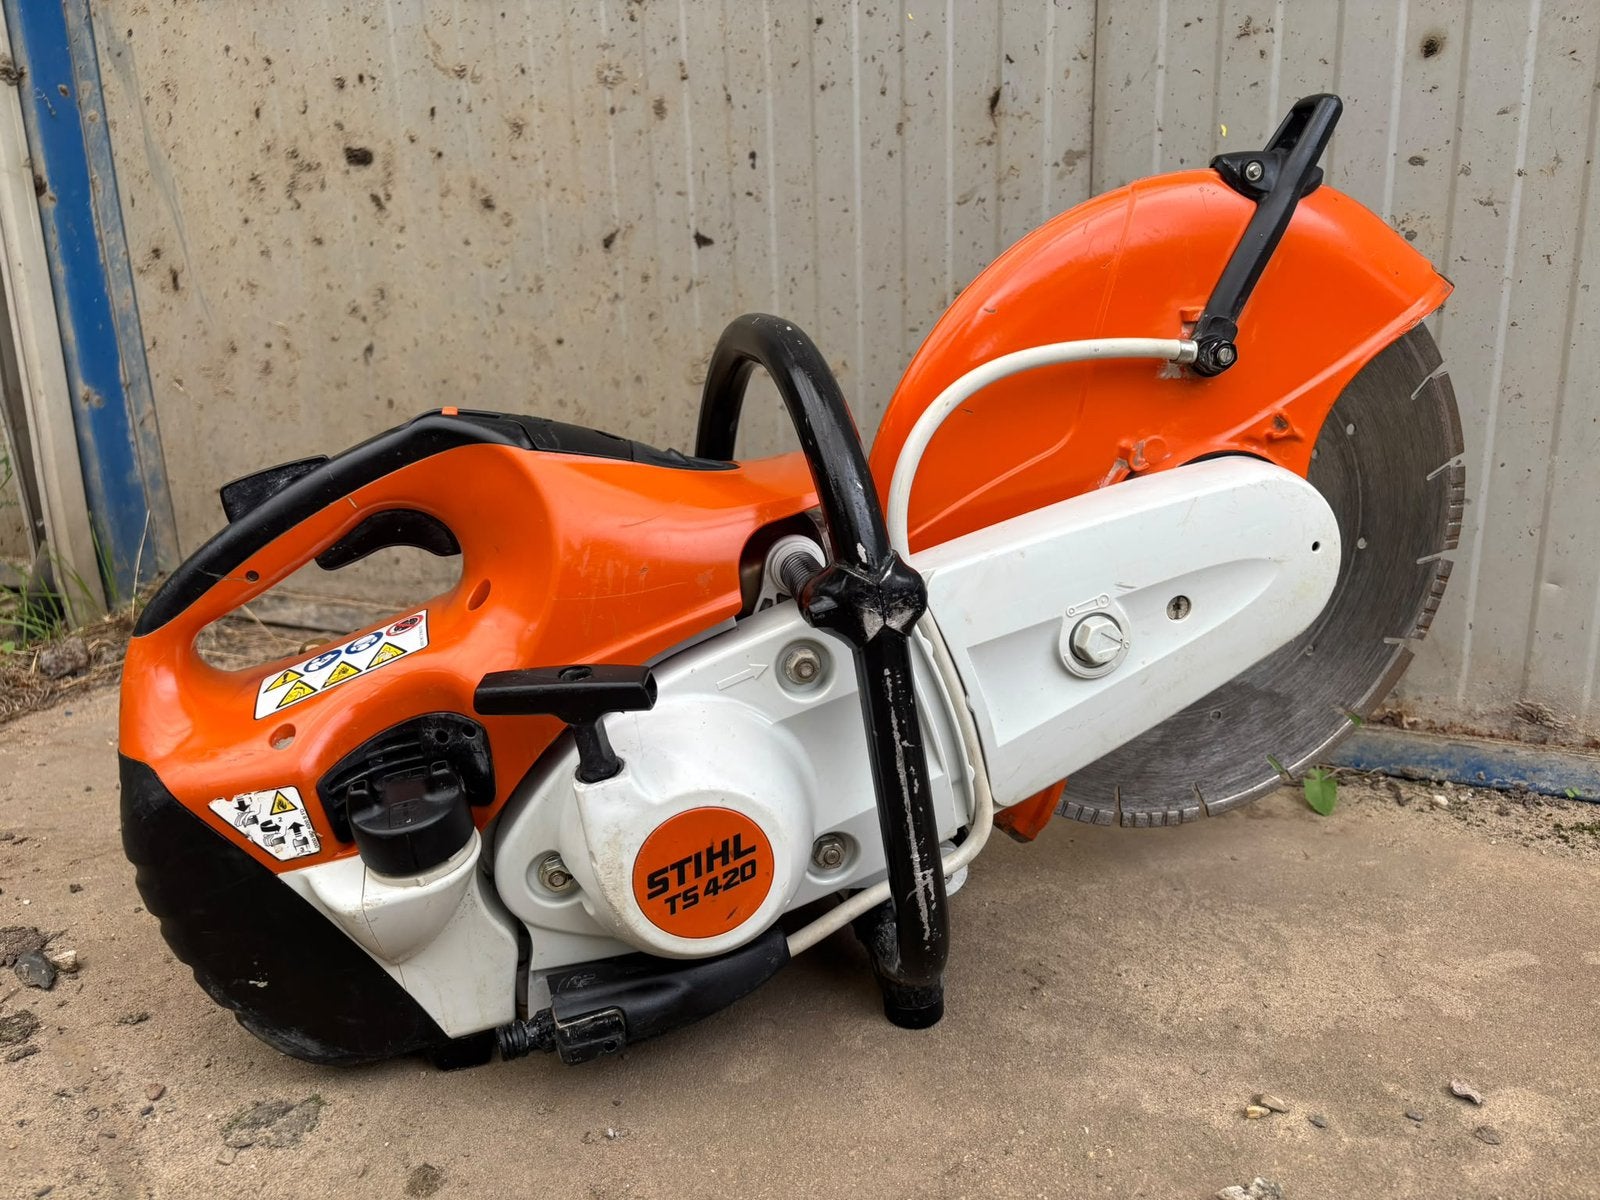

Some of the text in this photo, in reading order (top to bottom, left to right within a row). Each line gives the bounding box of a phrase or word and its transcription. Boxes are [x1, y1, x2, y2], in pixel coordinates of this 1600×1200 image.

[647, 833, 757, 900] STIHL
[664, 859, 757, 915] TS 420
